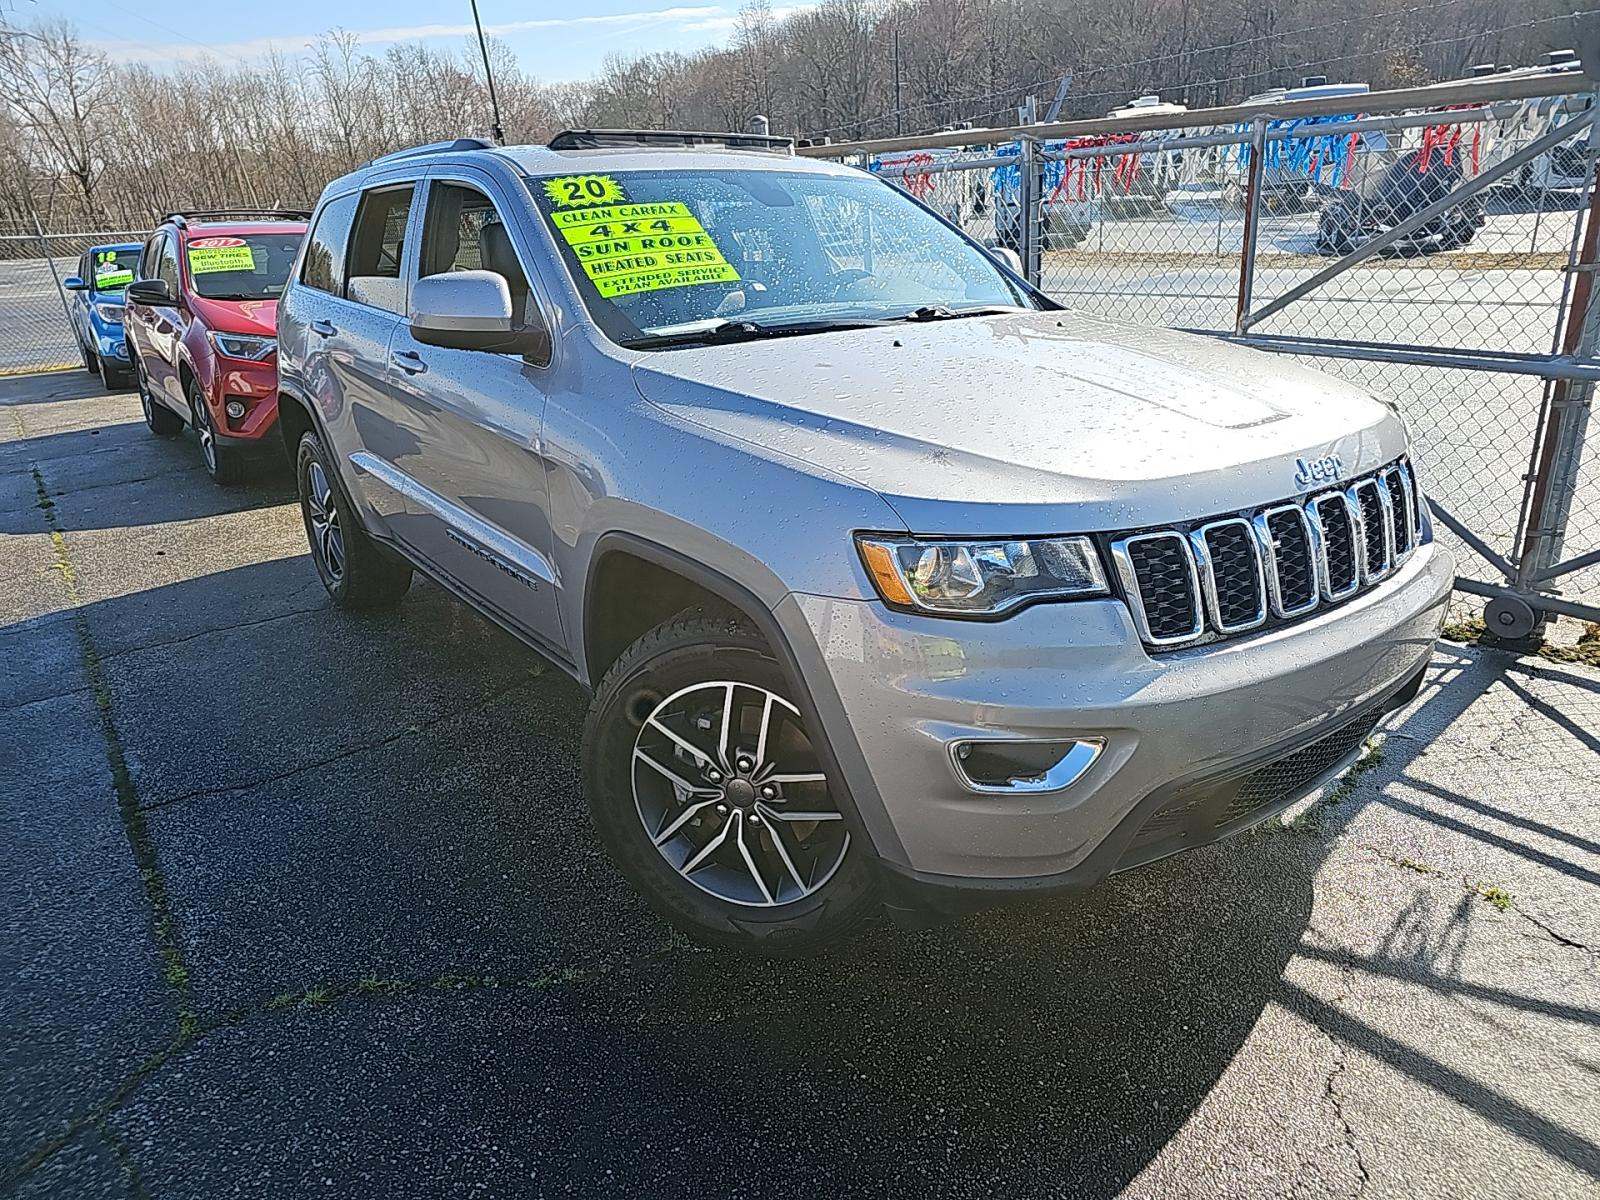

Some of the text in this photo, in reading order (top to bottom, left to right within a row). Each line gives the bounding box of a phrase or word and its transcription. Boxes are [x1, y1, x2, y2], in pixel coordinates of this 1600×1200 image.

[563, 180, 606, 201] 20
[562, 205, 678, 223] CLEAN CARFAX
[97, 251, 117, 263] 18
[578, 235, 706, 258] SUN ROOF
[591, 251, 716, 275] HEATED SEATS
[603, 266, 729, 288] EXTENDED SERVICE
[616, 273, 724, 293] PLAN AVAILABLE
[1294, 456, 1342, 486] Jeep
